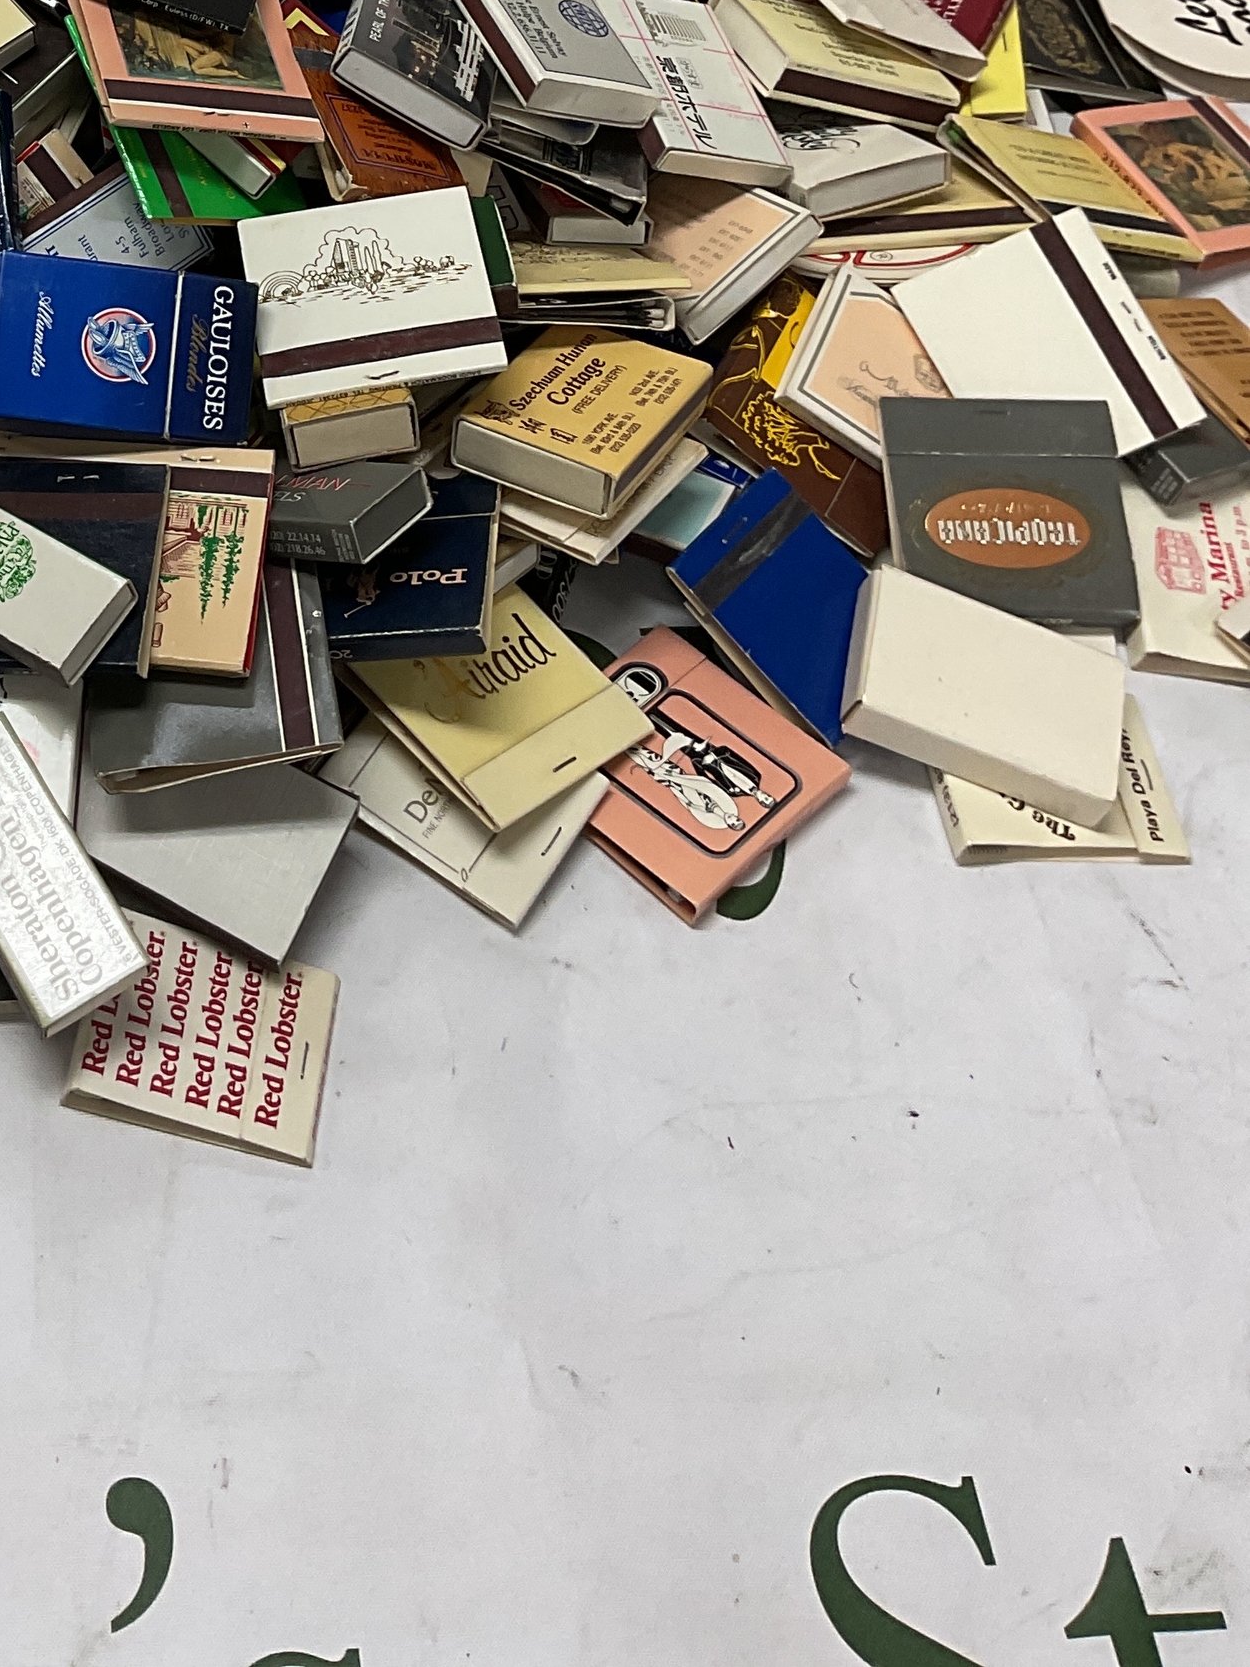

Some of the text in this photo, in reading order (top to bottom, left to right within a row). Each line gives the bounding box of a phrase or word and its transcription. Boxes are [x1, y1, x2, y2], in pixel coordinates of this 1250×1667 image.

[369, 21, 384, 42] PEARL
[30, 290, 53, 379] Allumettes
[186, 313, 210, 393] Blondes
[202, 285, 235, 431] GAULOISES
[511, 333, 598, 412] Szechuan Hunan
[547, 357, 606, 405] Cottage
[572, 394, 596, 414] (FREE
[591, 365, 628, 397] DELIVERY)
[937, 518, 1081, 547] TROPICANA
[1198, 501, 1230, 584] Marina
[390, 568, 468, 586] Polo
[1032, 809, 1077, 842] The
[1132, 776, 1165, 843] Playa Del
[3, 818, 104, 987] Copenhagen
[0, 872, 80, 1002] Sheraton
[82, 1017, 114, 1076] Red
[116, 1028, 147, 1088] Red
[150, 1040, 181, 1098] Red
[185, 1052, 217, 1110] Red
[217, 1062, 249, 1119] Red
[254, 1071, 284, 1130] Red
